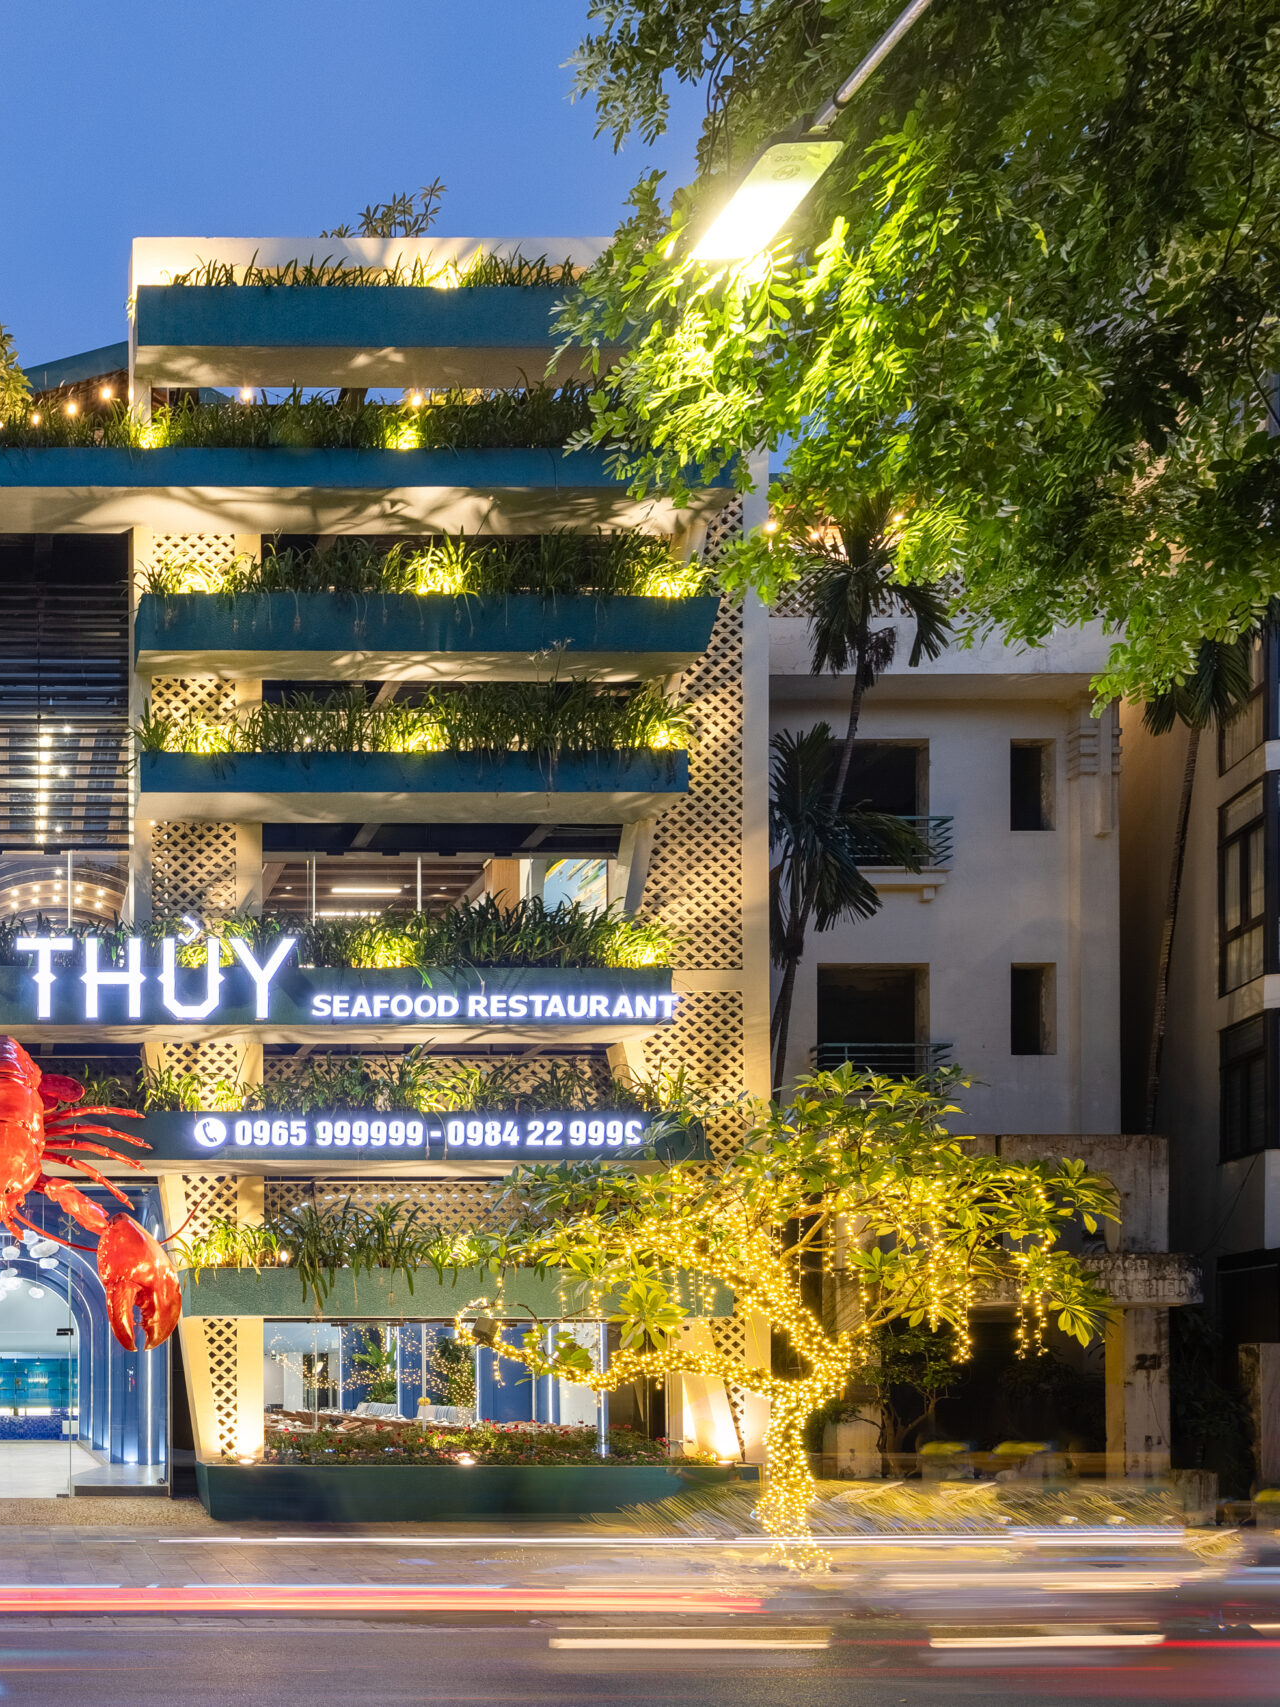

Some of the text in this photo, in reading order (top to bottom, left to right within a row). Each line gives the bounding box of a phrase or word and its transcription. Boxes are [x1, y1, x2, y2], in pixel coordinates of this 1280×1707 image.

[17, 916, 297, 1019] THỦY
[312, 994, 677, 1018] SEAFOOD RESTAURANT
[235, 1120, 307, 1146] 0965
[316, 1121, 423, 1146] 999999
[448, 1120, 519, 1146] 0984
[526, 1120, 563, 1146] 22
